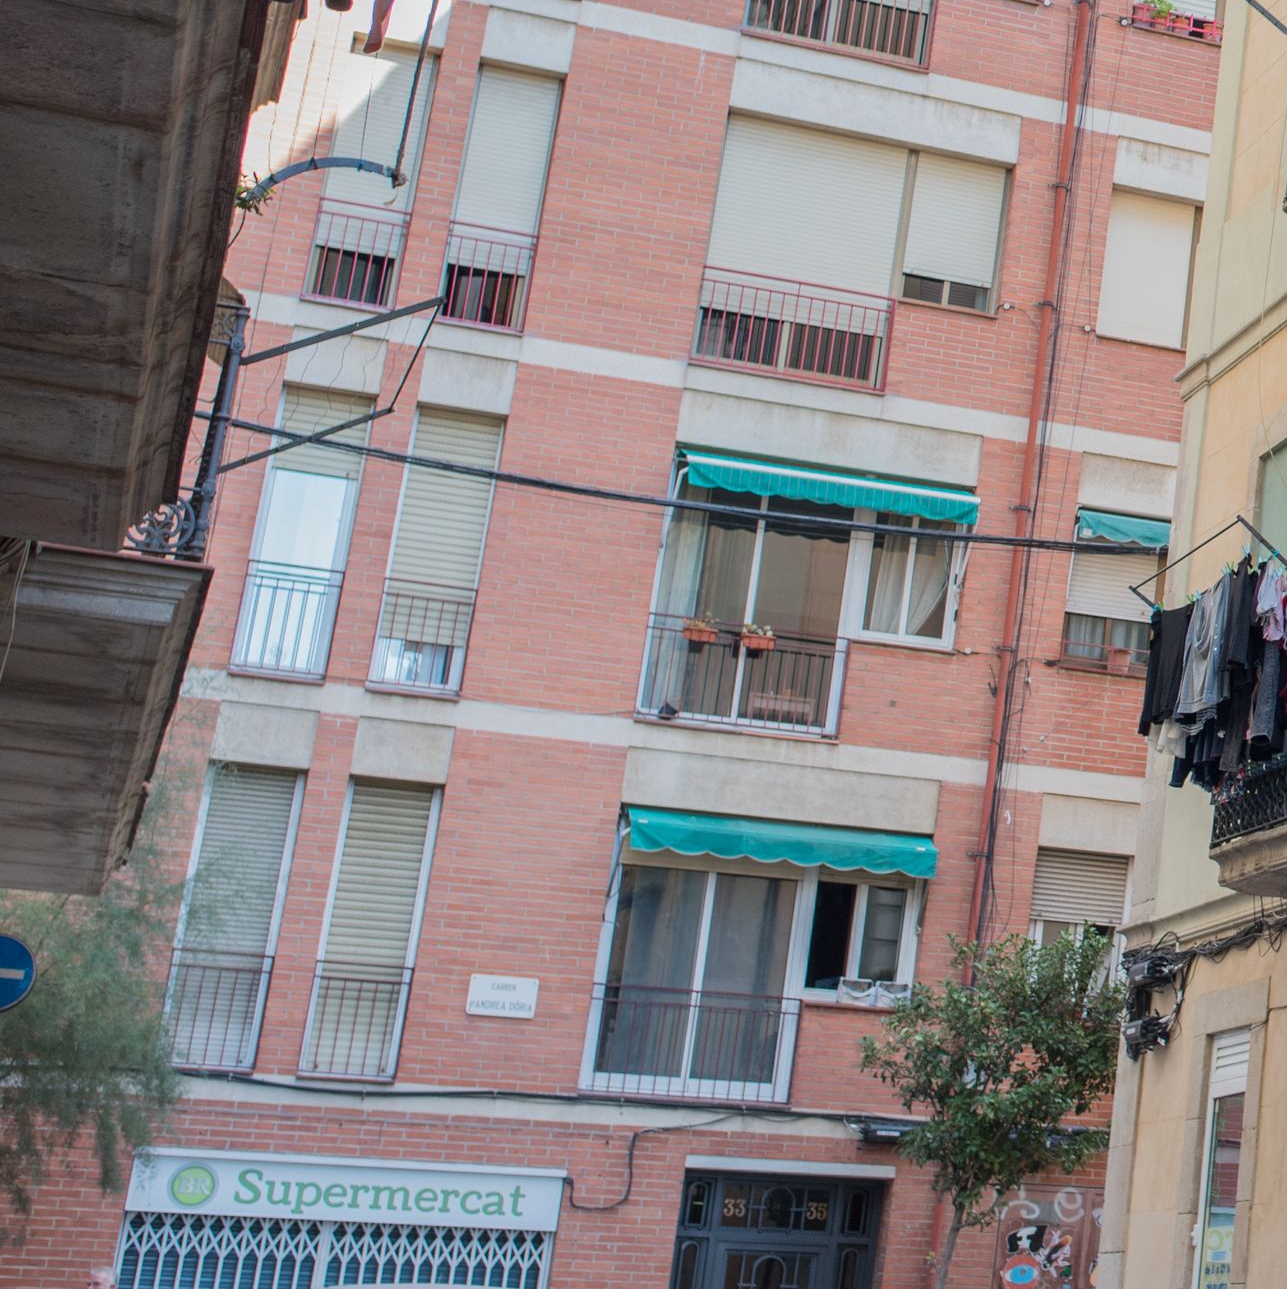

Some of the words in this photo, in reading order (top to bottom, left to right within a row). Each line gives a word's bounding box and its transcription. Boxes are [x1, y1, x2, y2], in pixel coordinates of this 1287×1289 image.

[491, 982, 517, 992] CARRER
[178, 1175, 210, 1196] BR
[233, 1168, 526, 1217] Supermercat
[723, 1198, 747, 1217] 33
[806, 1201, 828, 1221] 35
